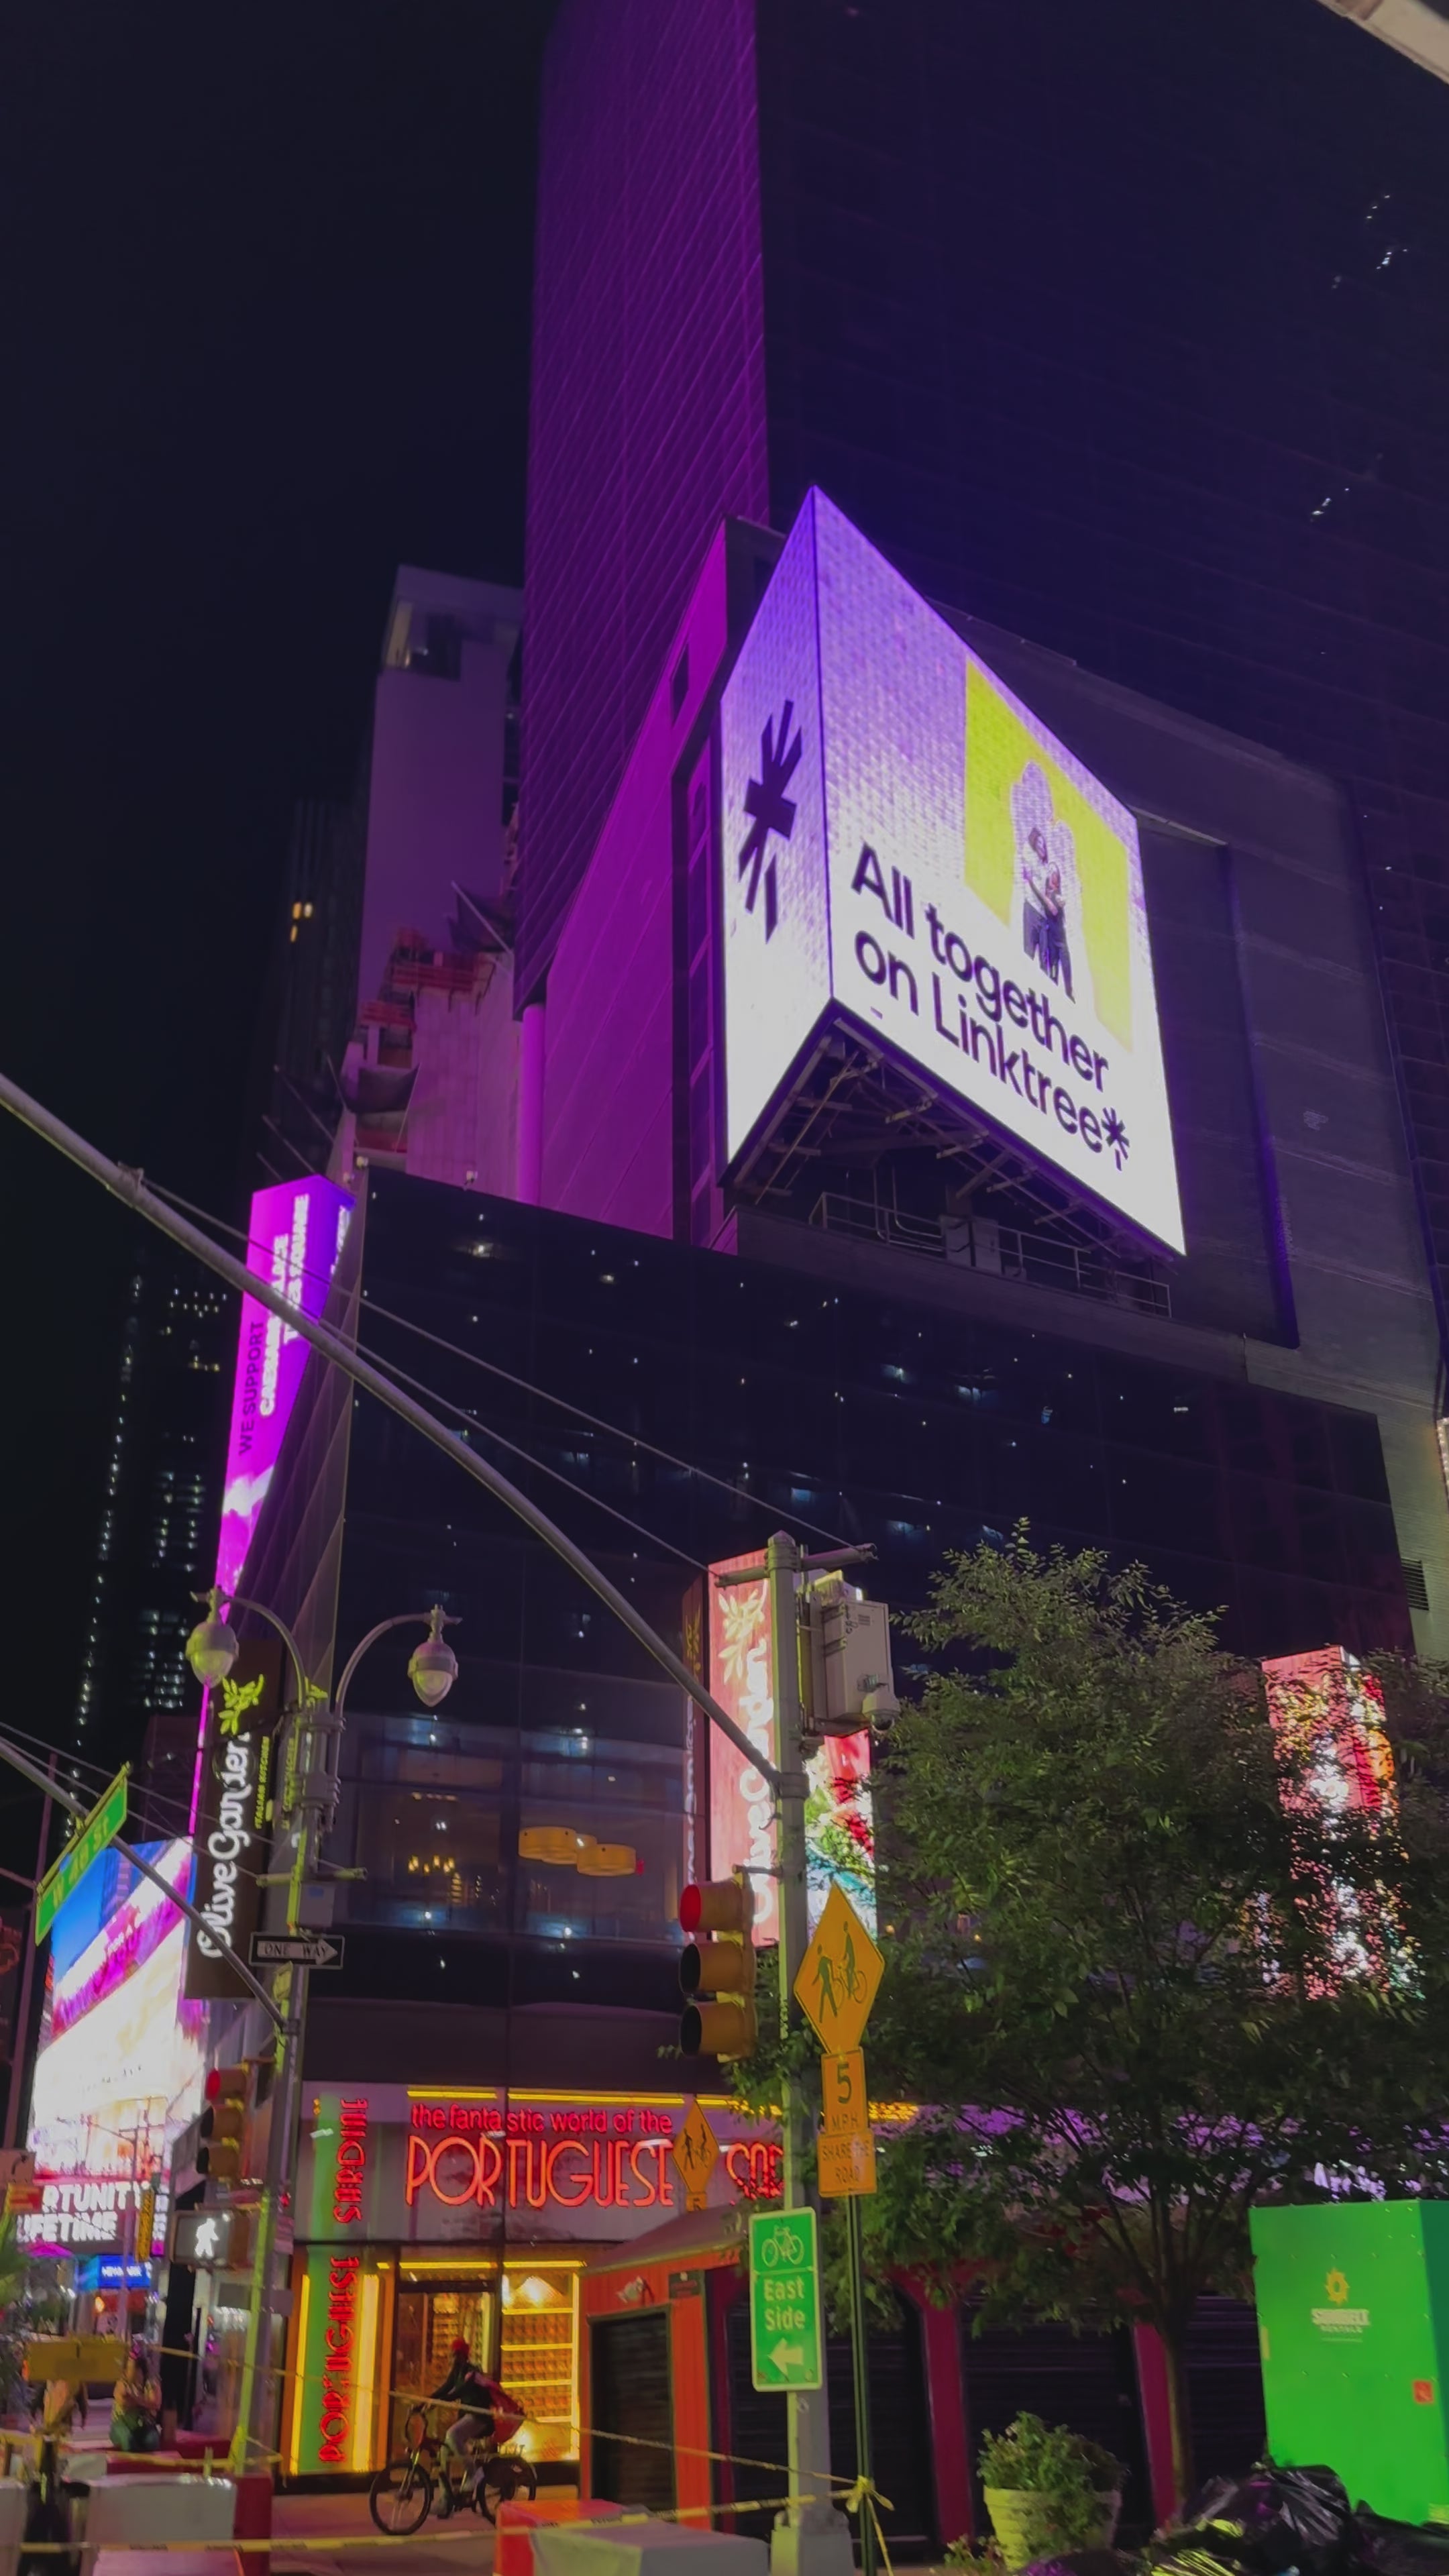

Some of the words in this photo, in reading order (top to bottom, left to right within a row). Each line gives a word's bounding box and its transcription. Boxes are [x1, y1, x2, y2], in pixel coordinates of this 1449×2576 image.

[851, 841, 915, 941] All
[924, 902, 1110, 1093] together
[854, 930, 919, 1017] on
[244, 1321, 265, 1417] SUPPORT
[239, 1417, 256, 1456] WE
[208, 1731, 254, 1860] Garden
[197, 1862, 237, 1958] Olive
[264, 1942, 288, 1957] ONE
[302, 1943, 328, 1958] WAY
[837, 2063, 852, 2105] 5
[412, 2104, 445, 2129] the
[450, 2104, 545, 2133] fantastic
[550, 2109, 607, 2134] world
[613, 2108, 635, 2133] of
[639, 2110, 674, 2135] the
[830, 2110, 859, 2133] MPH
[333, 2097, 368, 2225] SARDINE
[405, 2135, 674, 2208] PORTUGUESE
[763, 2277, 804, 2302] East
[764, 2305, 805, 2330] Side
